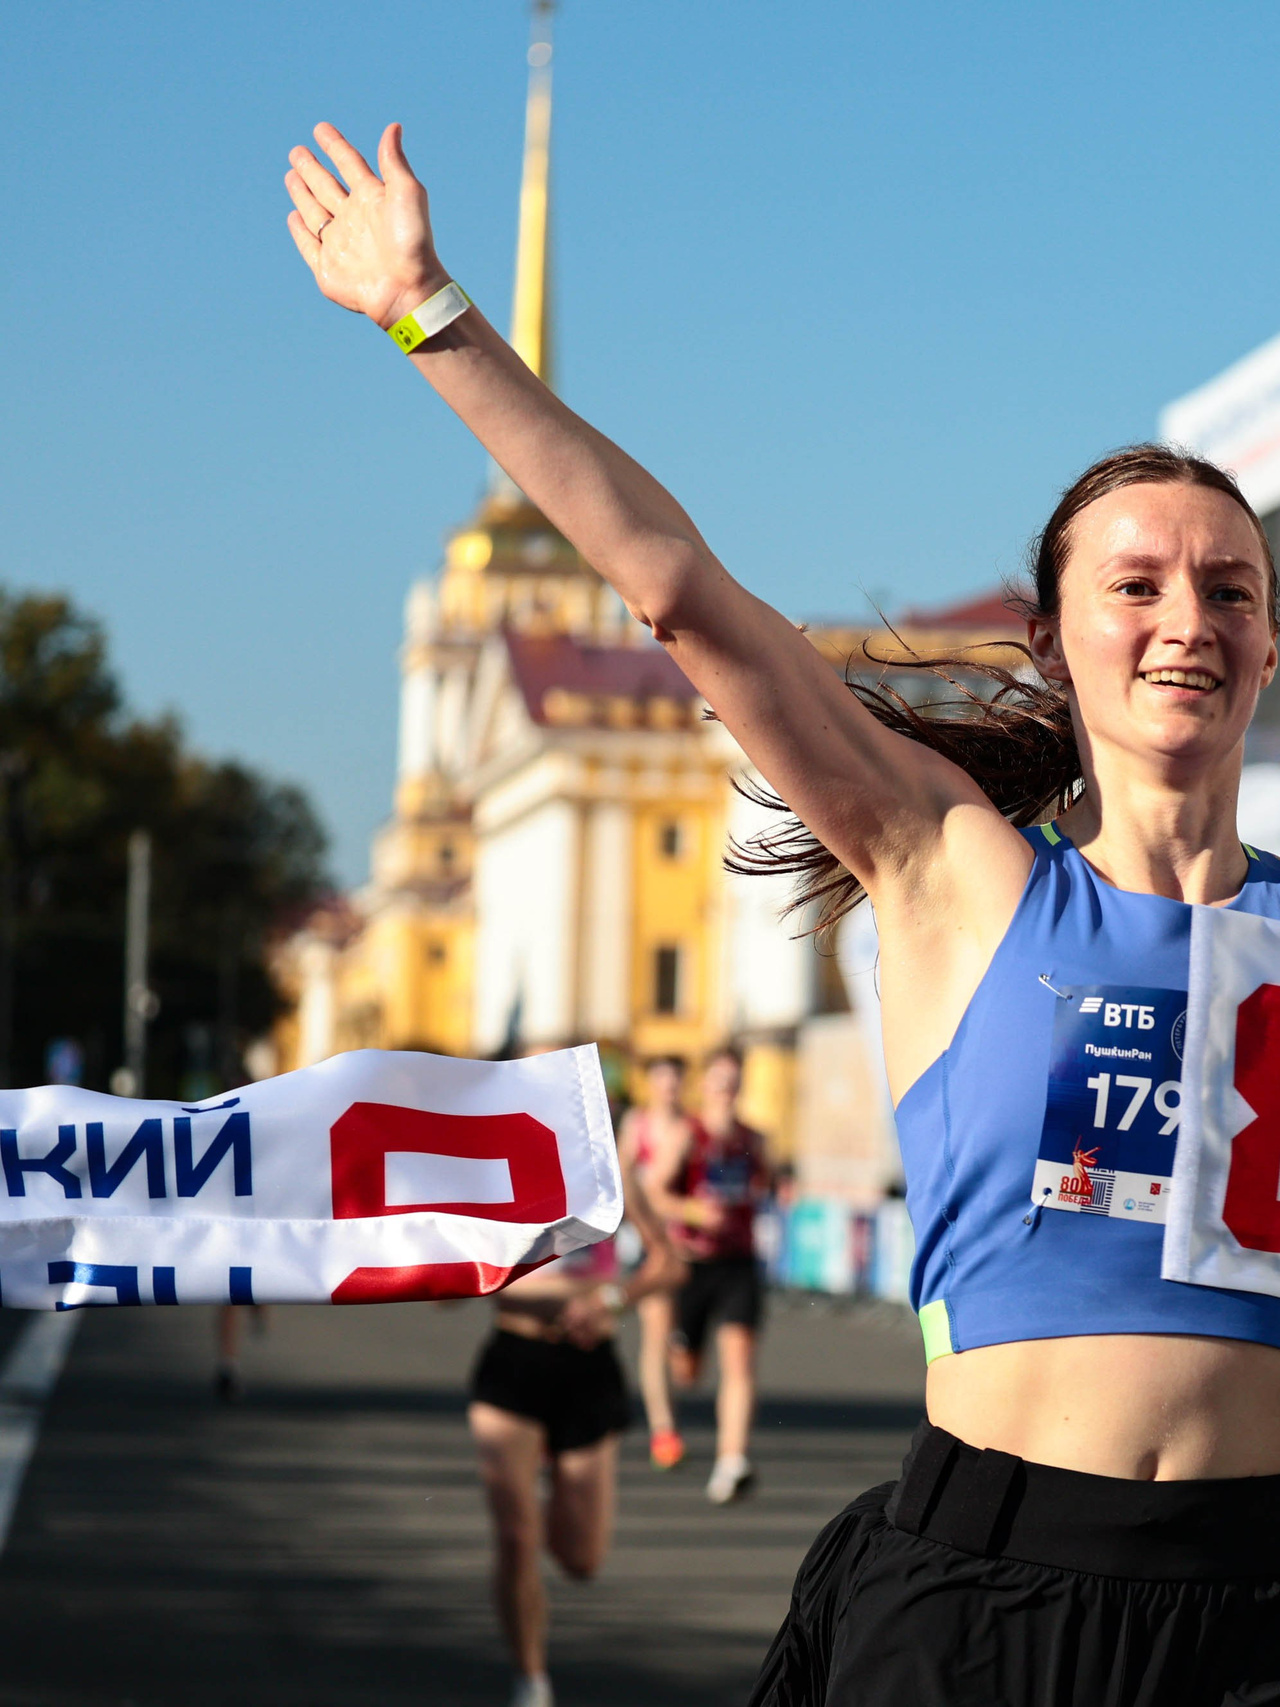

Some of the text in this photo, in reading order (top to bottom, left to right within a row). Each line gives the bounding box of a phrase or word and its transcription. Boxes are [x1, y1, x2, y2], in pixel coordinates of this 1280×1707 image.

[1103, 1003, 1156, 1031] ВТБ
[1084, 1043, 1153, 1061] ПушкинРан
[1087, 1072, 1183, 1136] 179
[1060, 1176, 1080, 1193] 80
